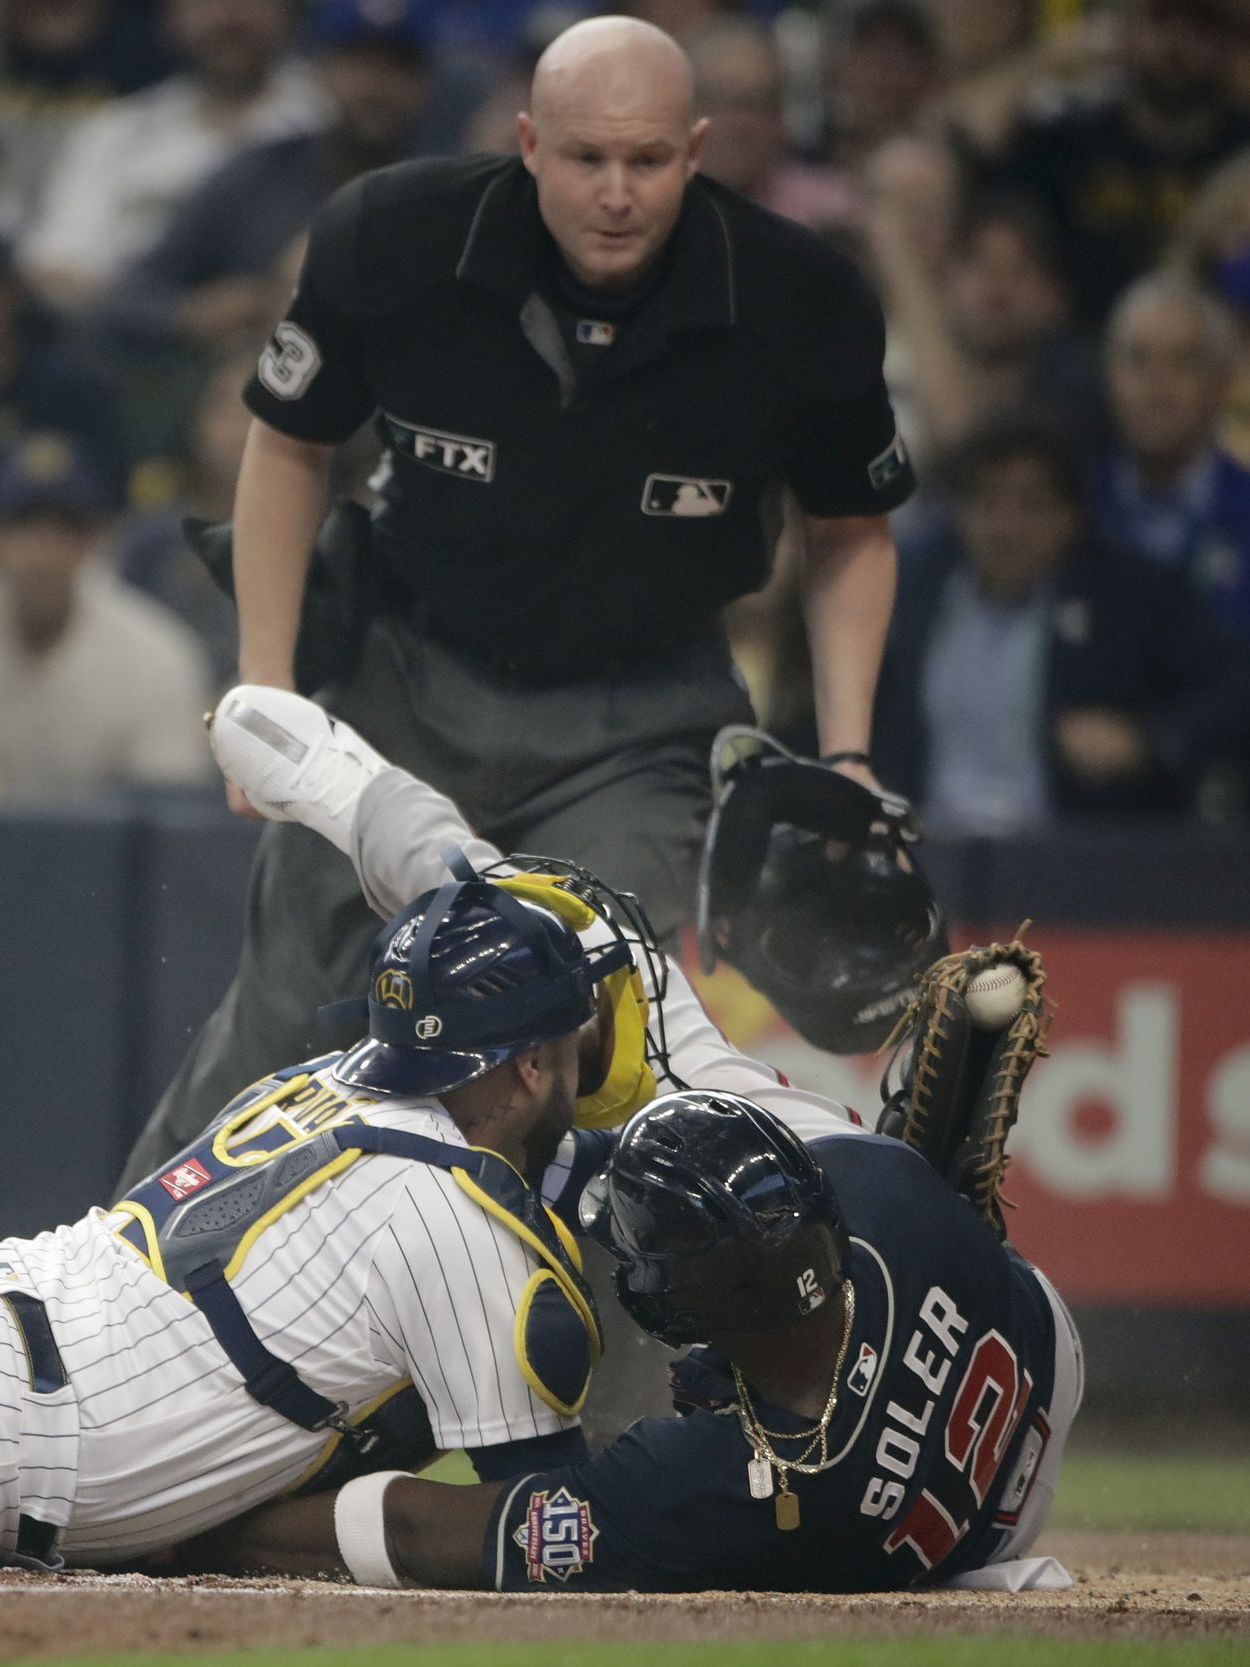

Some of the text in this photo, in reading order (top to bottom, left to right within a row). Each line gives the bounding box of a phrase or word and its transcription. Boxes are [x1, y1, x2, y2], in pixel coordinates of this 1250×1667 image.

[257, 321, 322, 400] 3
[414, 433, 488, 475] FTX
[796, 1268, 818, 1298] 12
[860, 1286, 969, 1521] SOLER
[882, 1327, 1033, 1571] 12
[542, 1500, 580, 1567] 150
